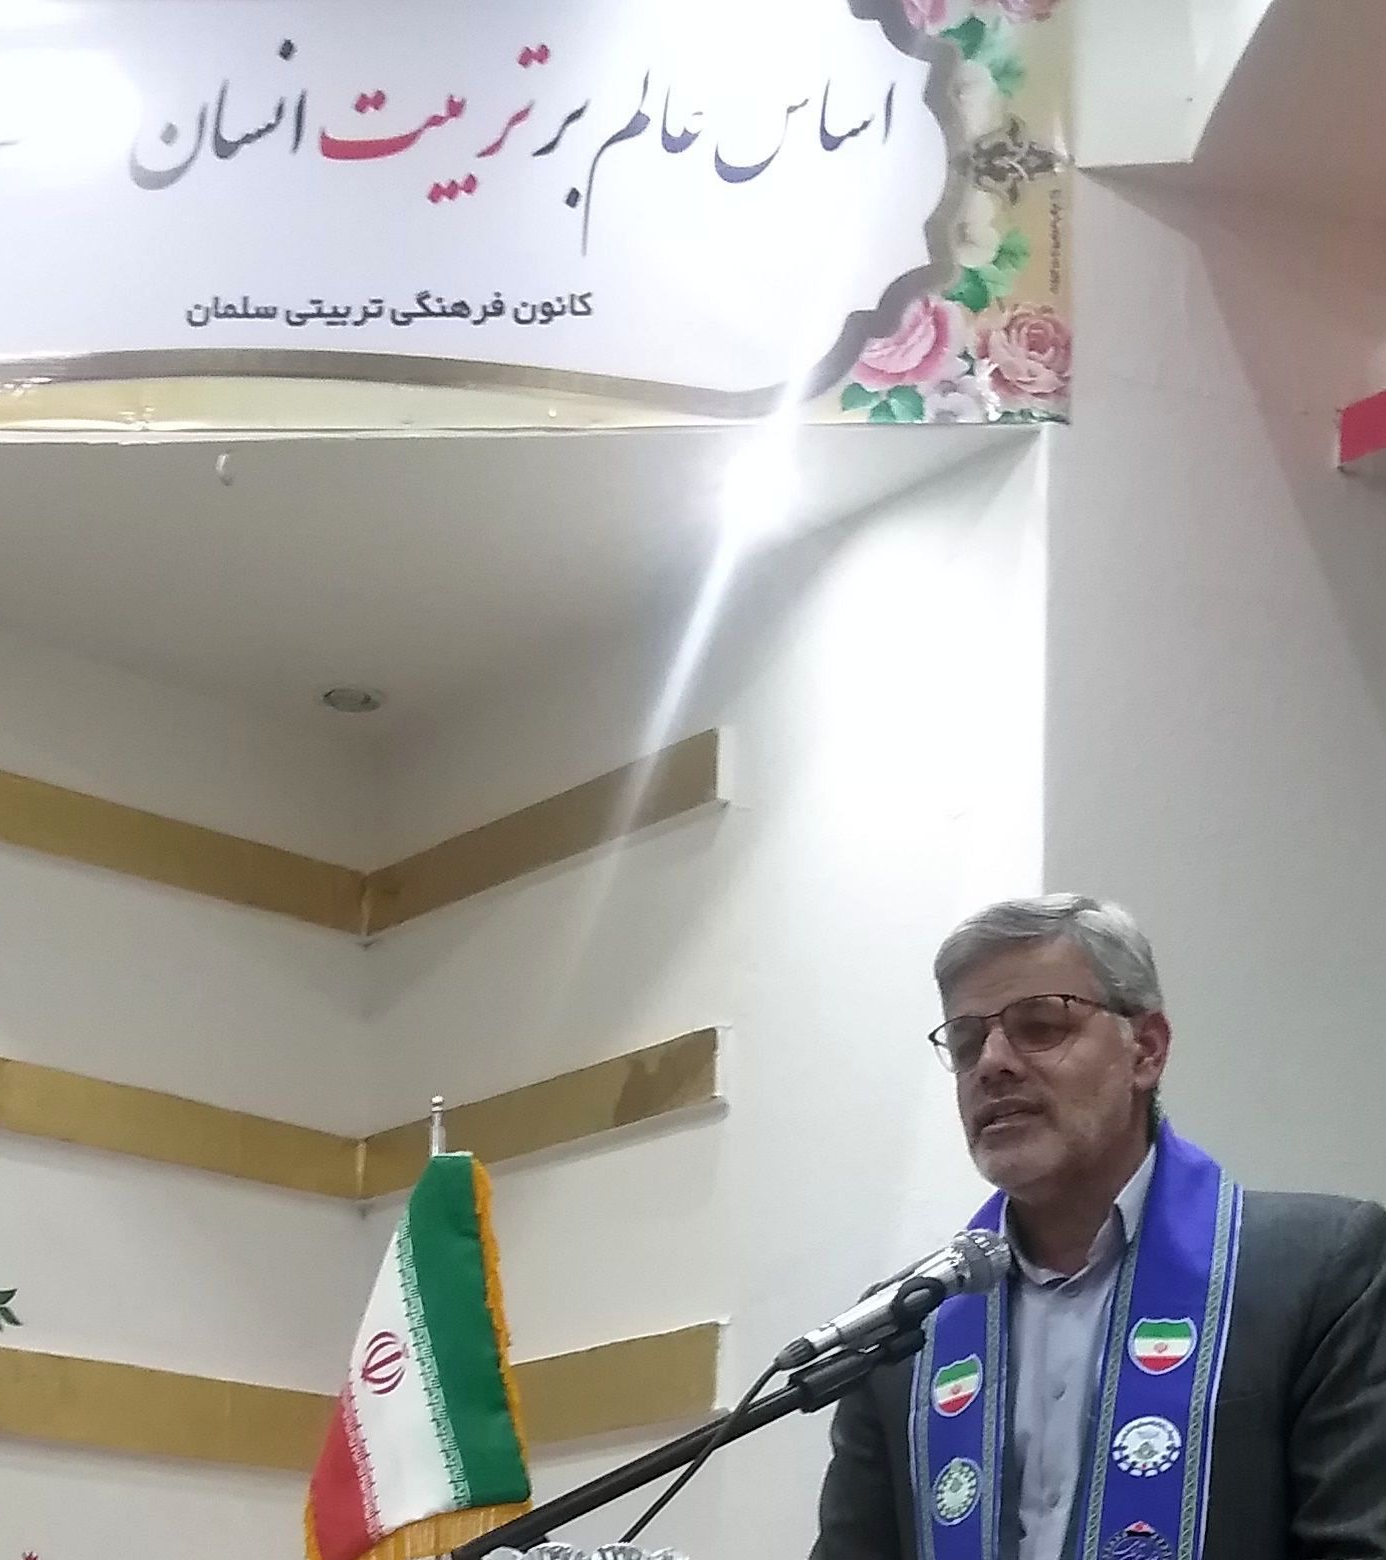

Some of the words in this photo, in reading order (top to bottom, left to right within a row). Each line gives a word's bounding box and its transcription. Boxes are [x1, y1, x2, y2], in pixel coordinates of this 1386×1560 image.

[128, 38, 308, 191] انسان
[317, 42, 551, 205] تربیت
[714, 78, 896, 184] اساس
[531, 98, 591, 210] بر
[185, 295, 280, 329] سلمان
[283, 297, 386, 328] تربیتی
[388, 289, 507, 327] فرهنگی
[511, 291, 593, 327] کانون
